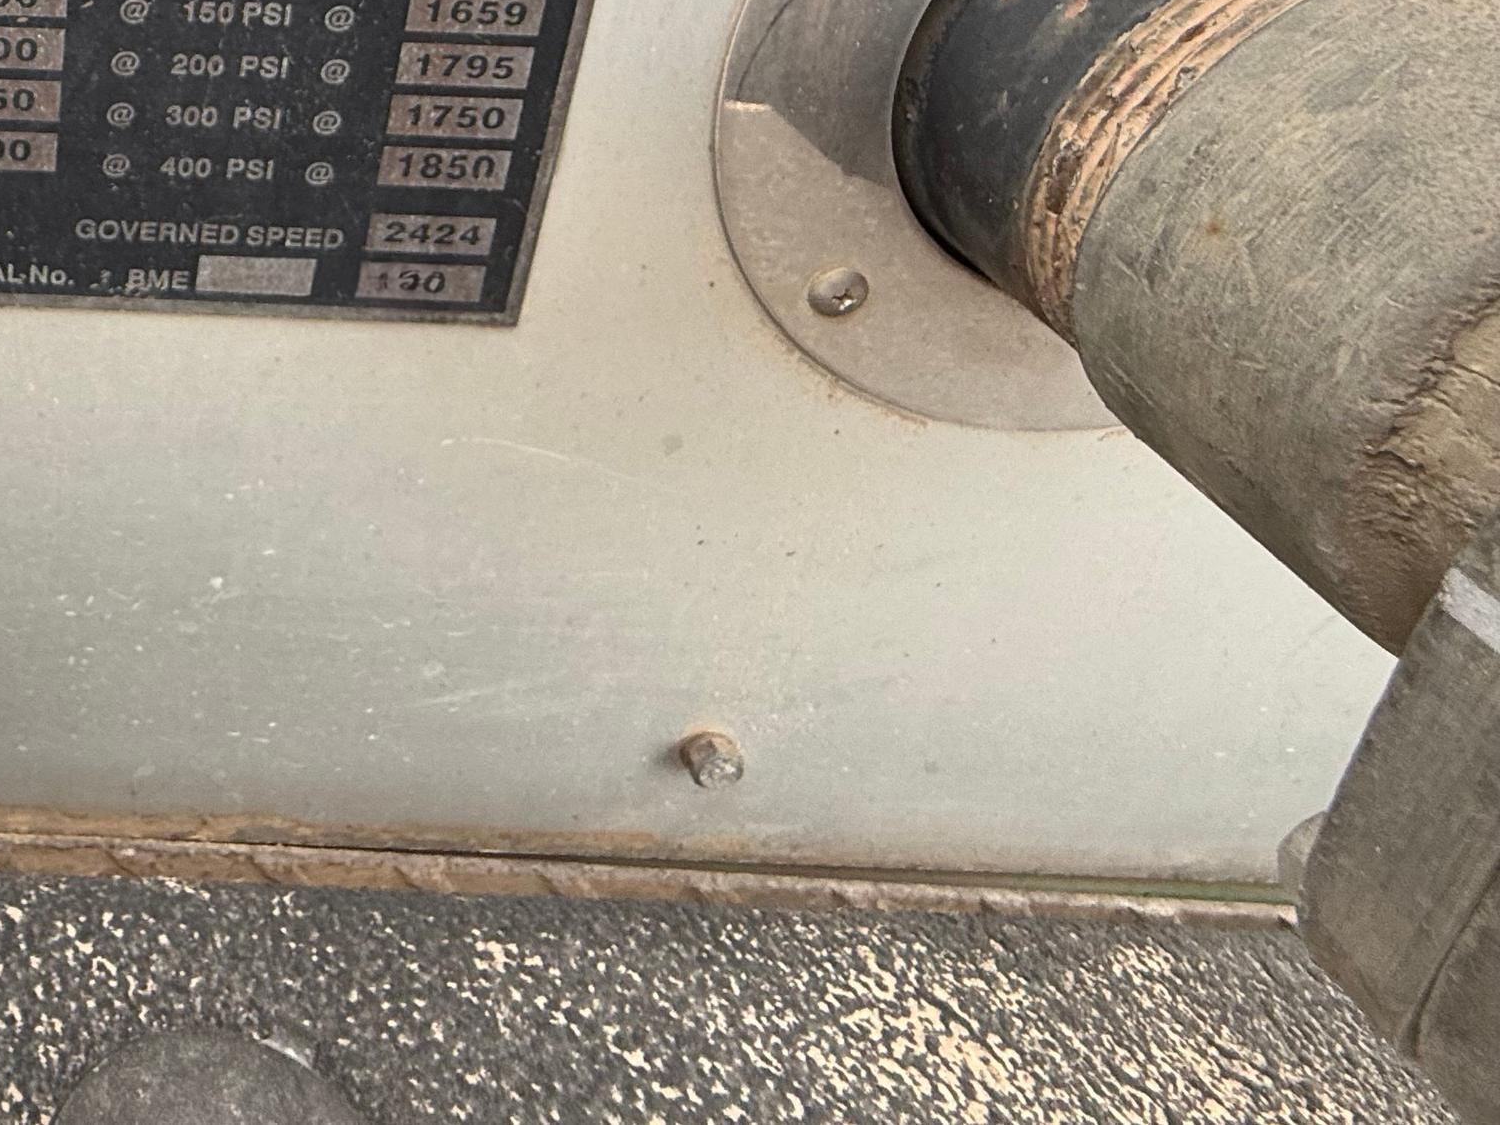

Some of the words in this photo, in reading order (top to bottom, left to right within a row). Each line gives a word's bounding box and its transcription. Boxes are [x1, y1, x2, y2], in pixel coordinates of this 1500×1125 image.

[183, 0, 234, 25] 150
[244, 2, 291, 26] PSI
[325, 5, 355, 31] @
[111, 51, 140, 76] @
[171, 53, 224, 76] 200
[239, 55, 289, 79] PSI
[320, 58, 350, 84] @
[416, 53, 515, 81] 1795
[107, 101, 135, 127] @
[165, 105, 217, 128] 300
[233, 106, 281, 130] PSI
[312, 110, 342, 135] @
[406, 103, 505, 130] 1750
[102, 152, 130, 178] @
[160, 156, 211, 178] 400
[226, 158, 274, 180] PSI
[305, 160, 334, 185] @
[399, 153, 496, 181] 1850
[75, 220, 239, 246] GOVERNED
[246, 224, 345, 249] SPEED
[384, 221, 480, 245] 2424
[29, 264, 76, 286] No.
[128, 268, 190, 290] BME
